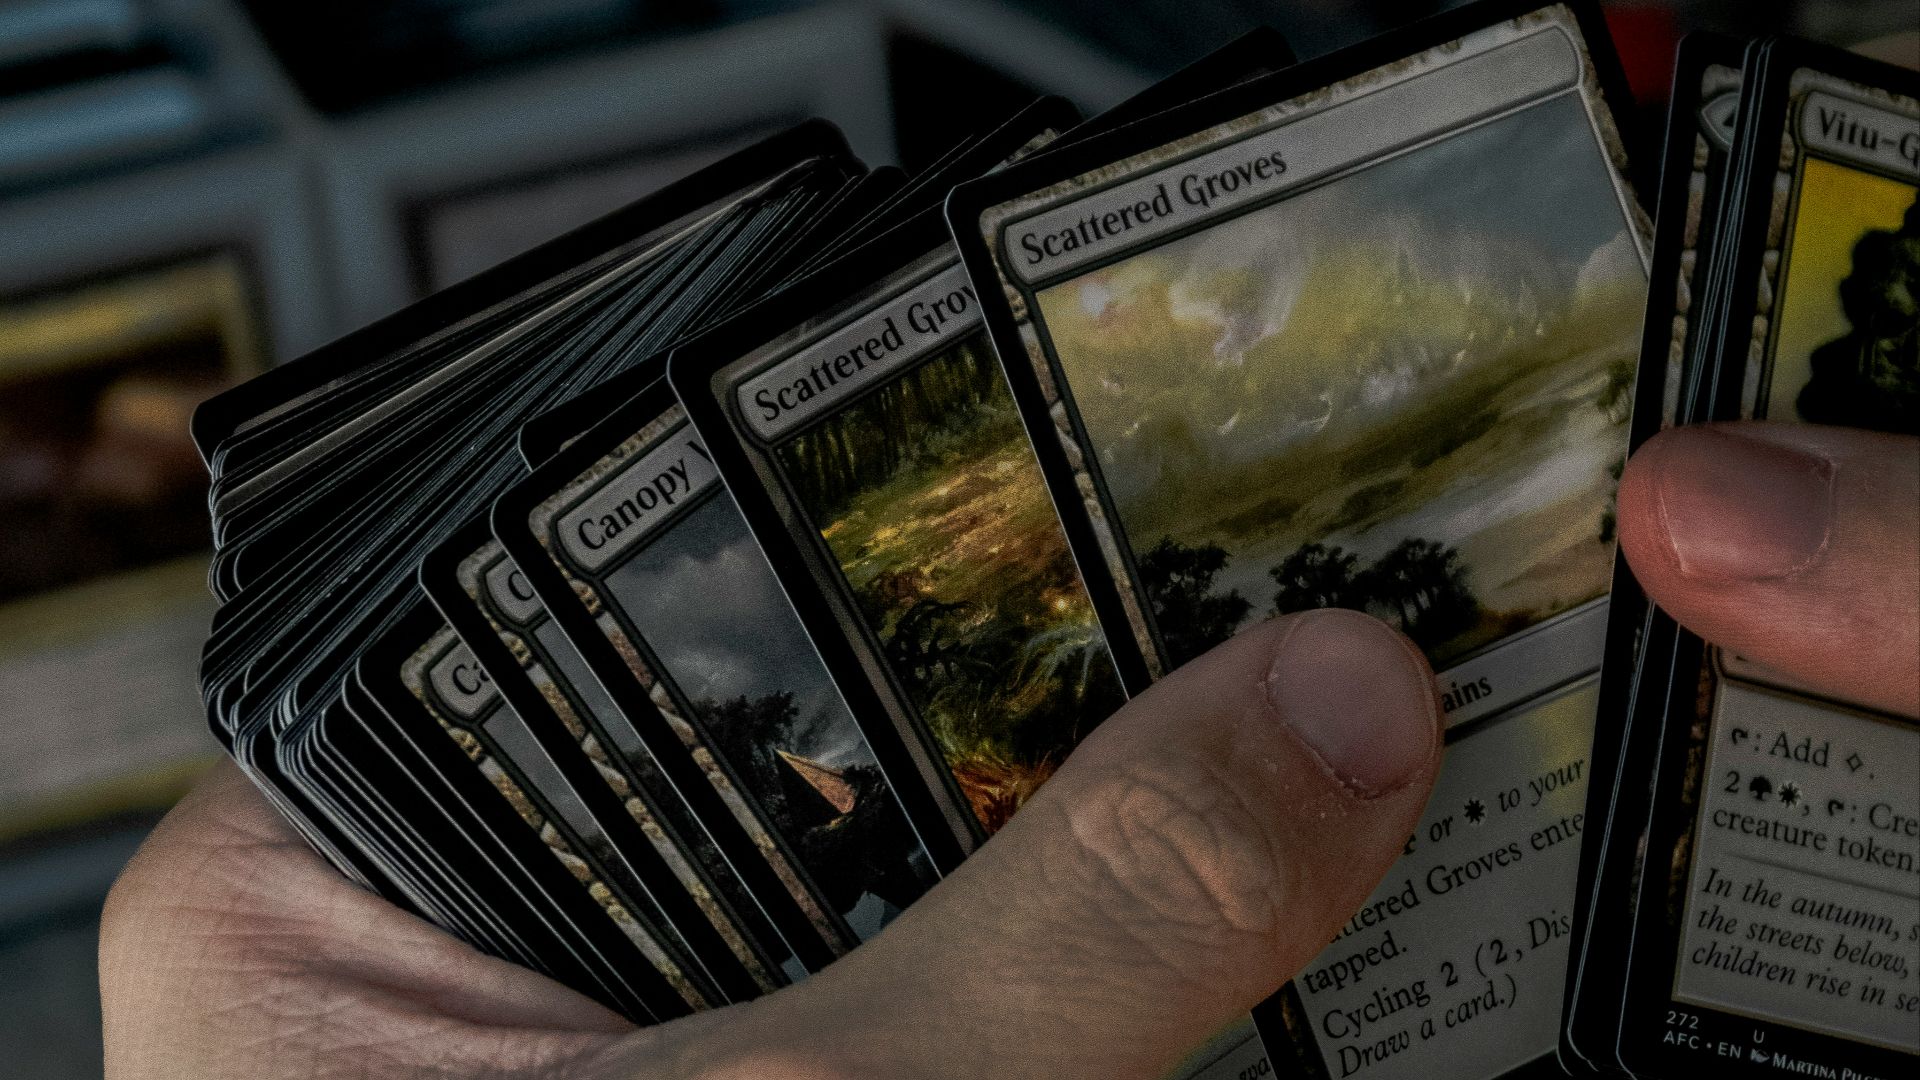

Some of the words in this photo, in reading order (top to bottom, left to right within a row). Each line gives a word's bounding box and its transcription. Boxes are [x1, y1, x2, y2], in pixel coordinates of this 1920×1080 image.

[1021, 184, 1174, 264] Scattered
[1179, 151, 1288, 208] Groves
[755, 316, 904, 422] Scattered
[578, 459, 691, 550] Canopy
[1429, 816, 1453, 842] or
[1498, 788, 1520, 812] to
[1529, 759, 1584, 807] your
[1713, 808, 1827, 851] creature
[1426, 843, 1523, 895] Groves
[1531, 813, 1584, 851] ente
[1698, 904, 1737, 935] the
[1746, 922, 1824, 955] streets
[1834, 934, 1908, 979] below,
[1702, 868, 1732, 898] In
[1742, 878, 1782, 909] the
[1791, 898, 1899, 941] autumn,
[1303, 929, 1407, 994] tapped.
[1323, 980, 1431, 1039] Cycling
[1441, 962, 1458, 987] 2
[1528, 910, 1570, 949] Dis
[1692, 941, 1796, 986] children
[1806, 967, 1851, 997] rise
[1861, 977, 1885, 1006] in
[1895, 994, 1919, 1012] se
[1338, 1031, 1410, 1079] Draw
[1421, 1018, 1436, 1040] a
[1445, 974, 1516, 1028] card.)
[1663, 1029, 1700, 1050] AFC
[1717, 1041, 1742, 1059] EN
[1666, 1010, 1699, 1030] 272
[1753, 1028, 1765, 1044] U
